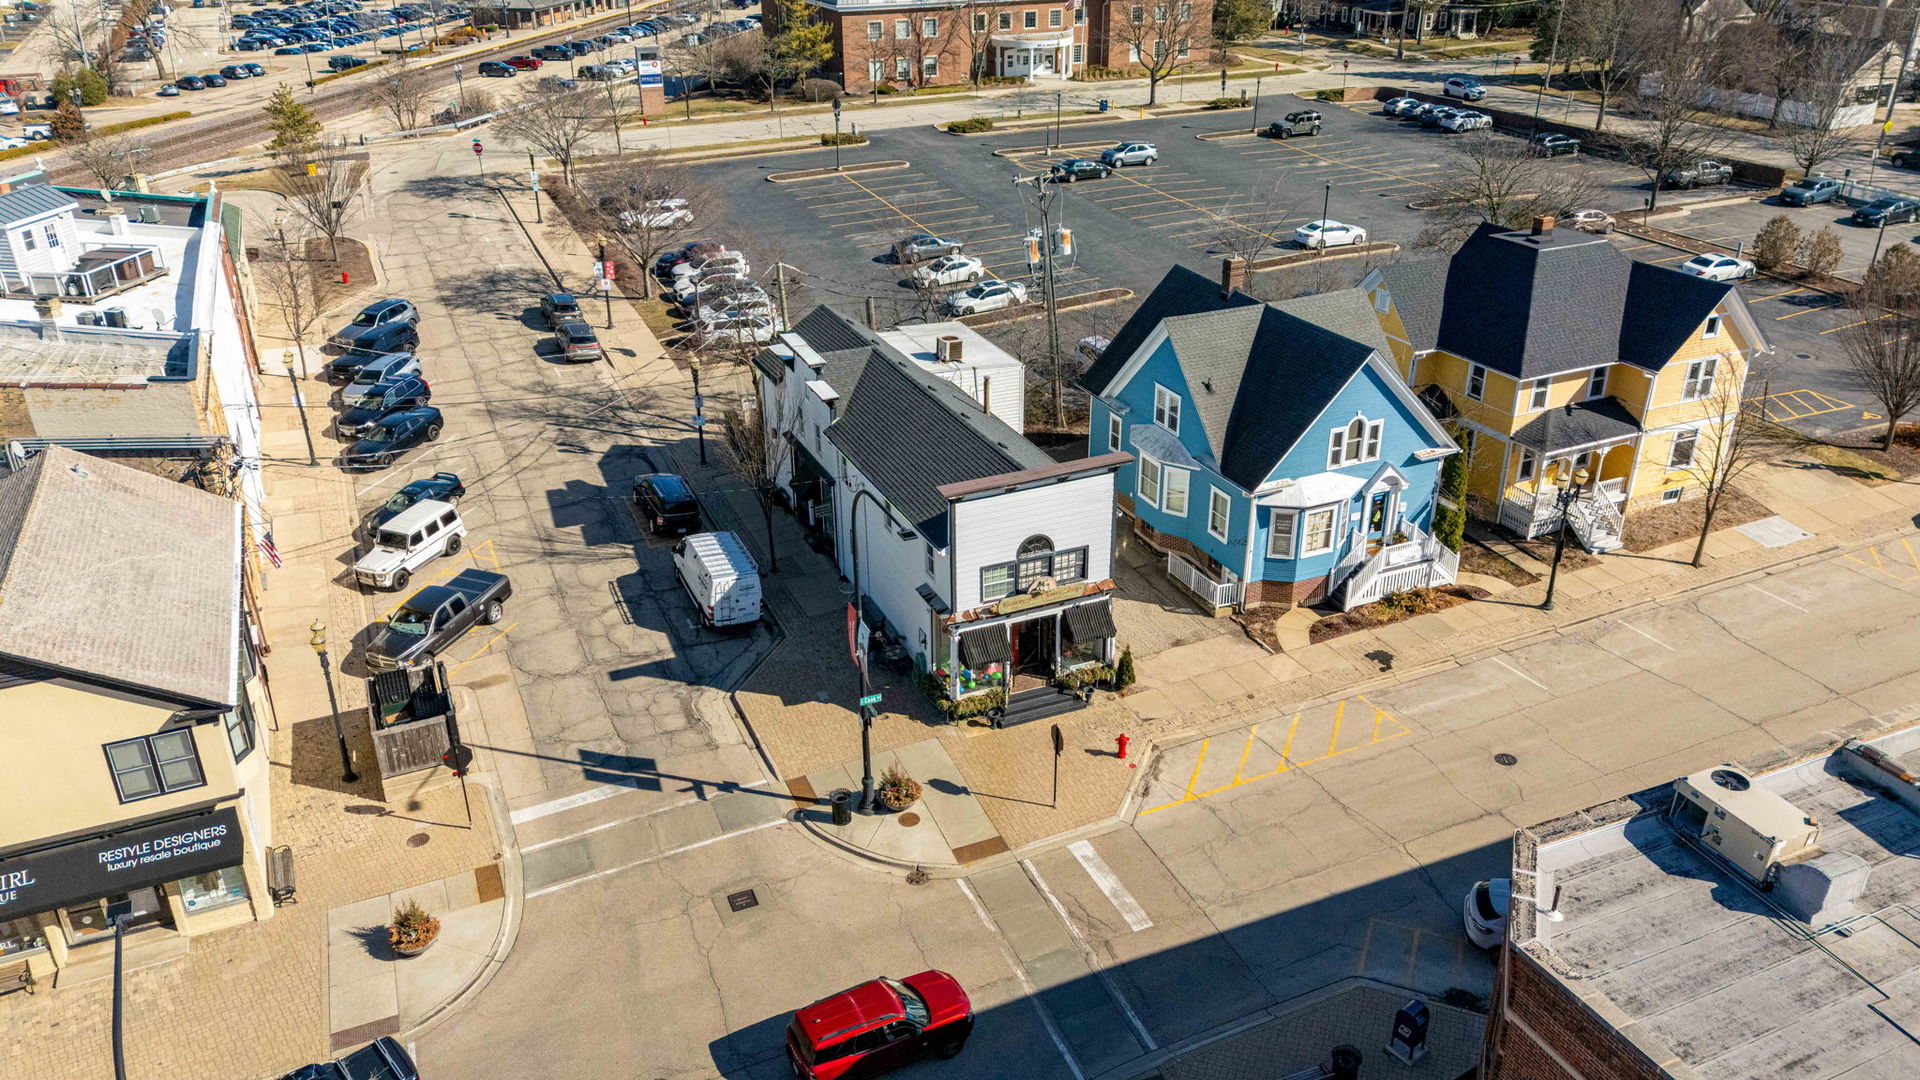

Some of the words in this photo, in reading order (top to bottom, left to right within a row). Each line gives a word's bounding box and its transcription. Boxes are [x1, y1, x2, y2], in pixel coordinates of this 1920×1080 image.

[98, 842, 151, 864] RESTYLE
[153, 824, 227, 851] DESIGNERS
[107, 858, 138, 872] luxury
[140, 850, 172, 864] resale
[173, 839, 222, 856] boutique
[0, 891, 17, 905] UE
